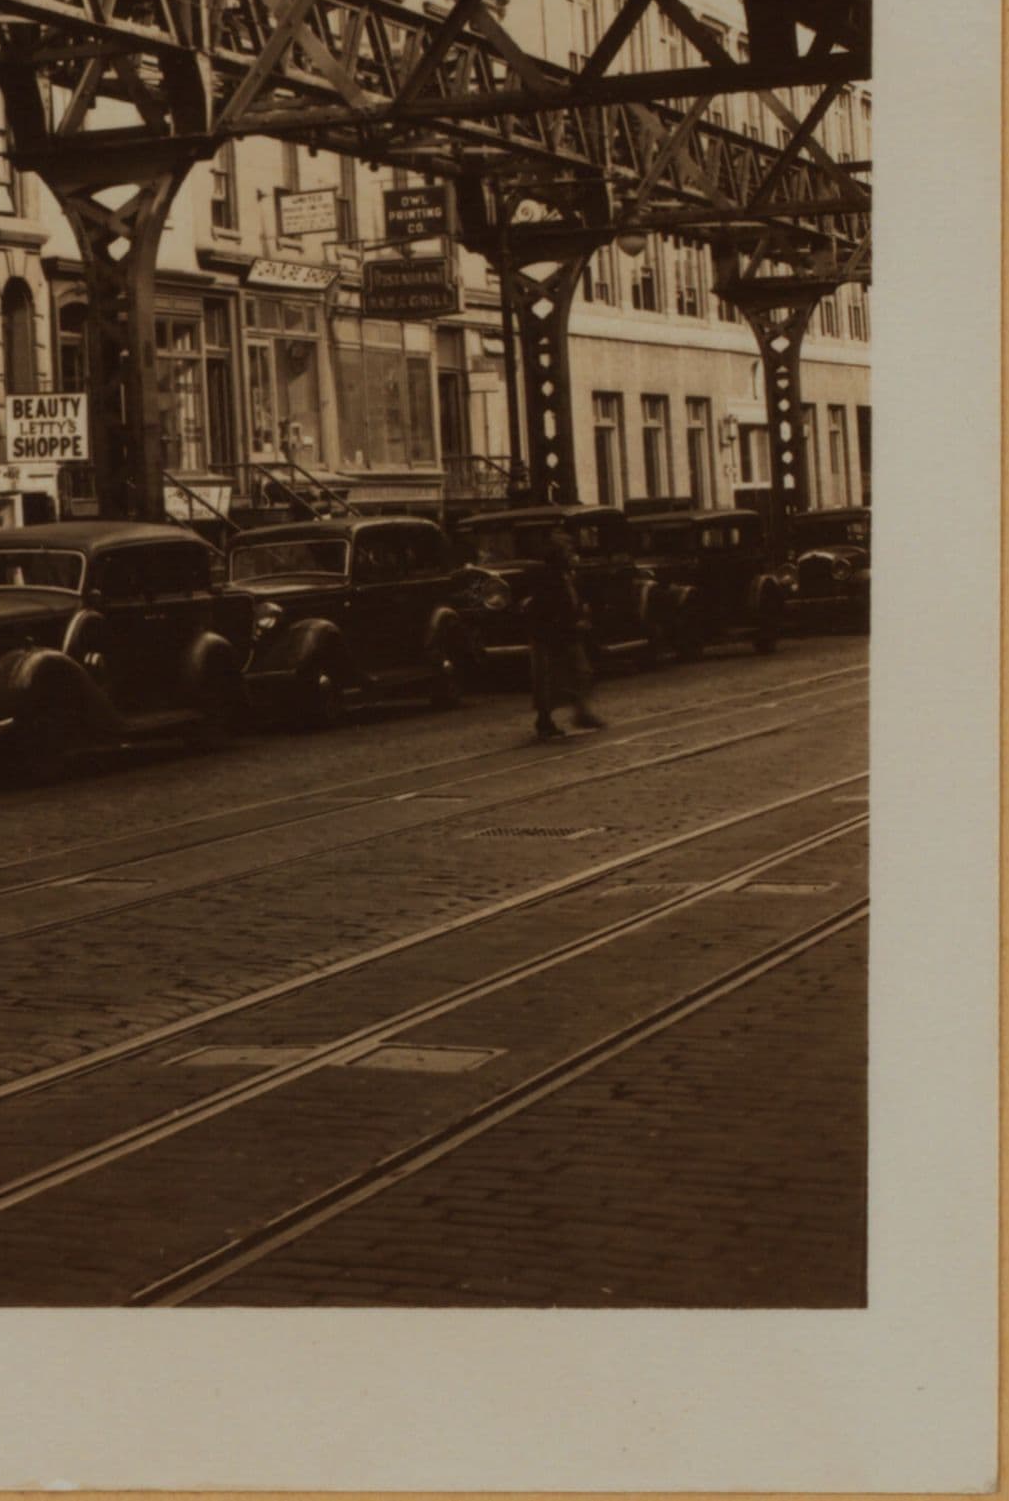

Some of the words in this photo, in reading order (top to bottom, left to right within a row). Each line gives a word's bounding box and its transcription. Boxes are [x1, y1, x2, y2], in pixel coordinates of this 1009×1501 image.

[400, 195, 429, 208] OWL
[388, 205, 444, 221] PRINTING
[12, 397, 82, 420] BEAUTY
[19, 421, 78, 437] LETTY'S
[12, 436, 83, 458] SHOPPE
